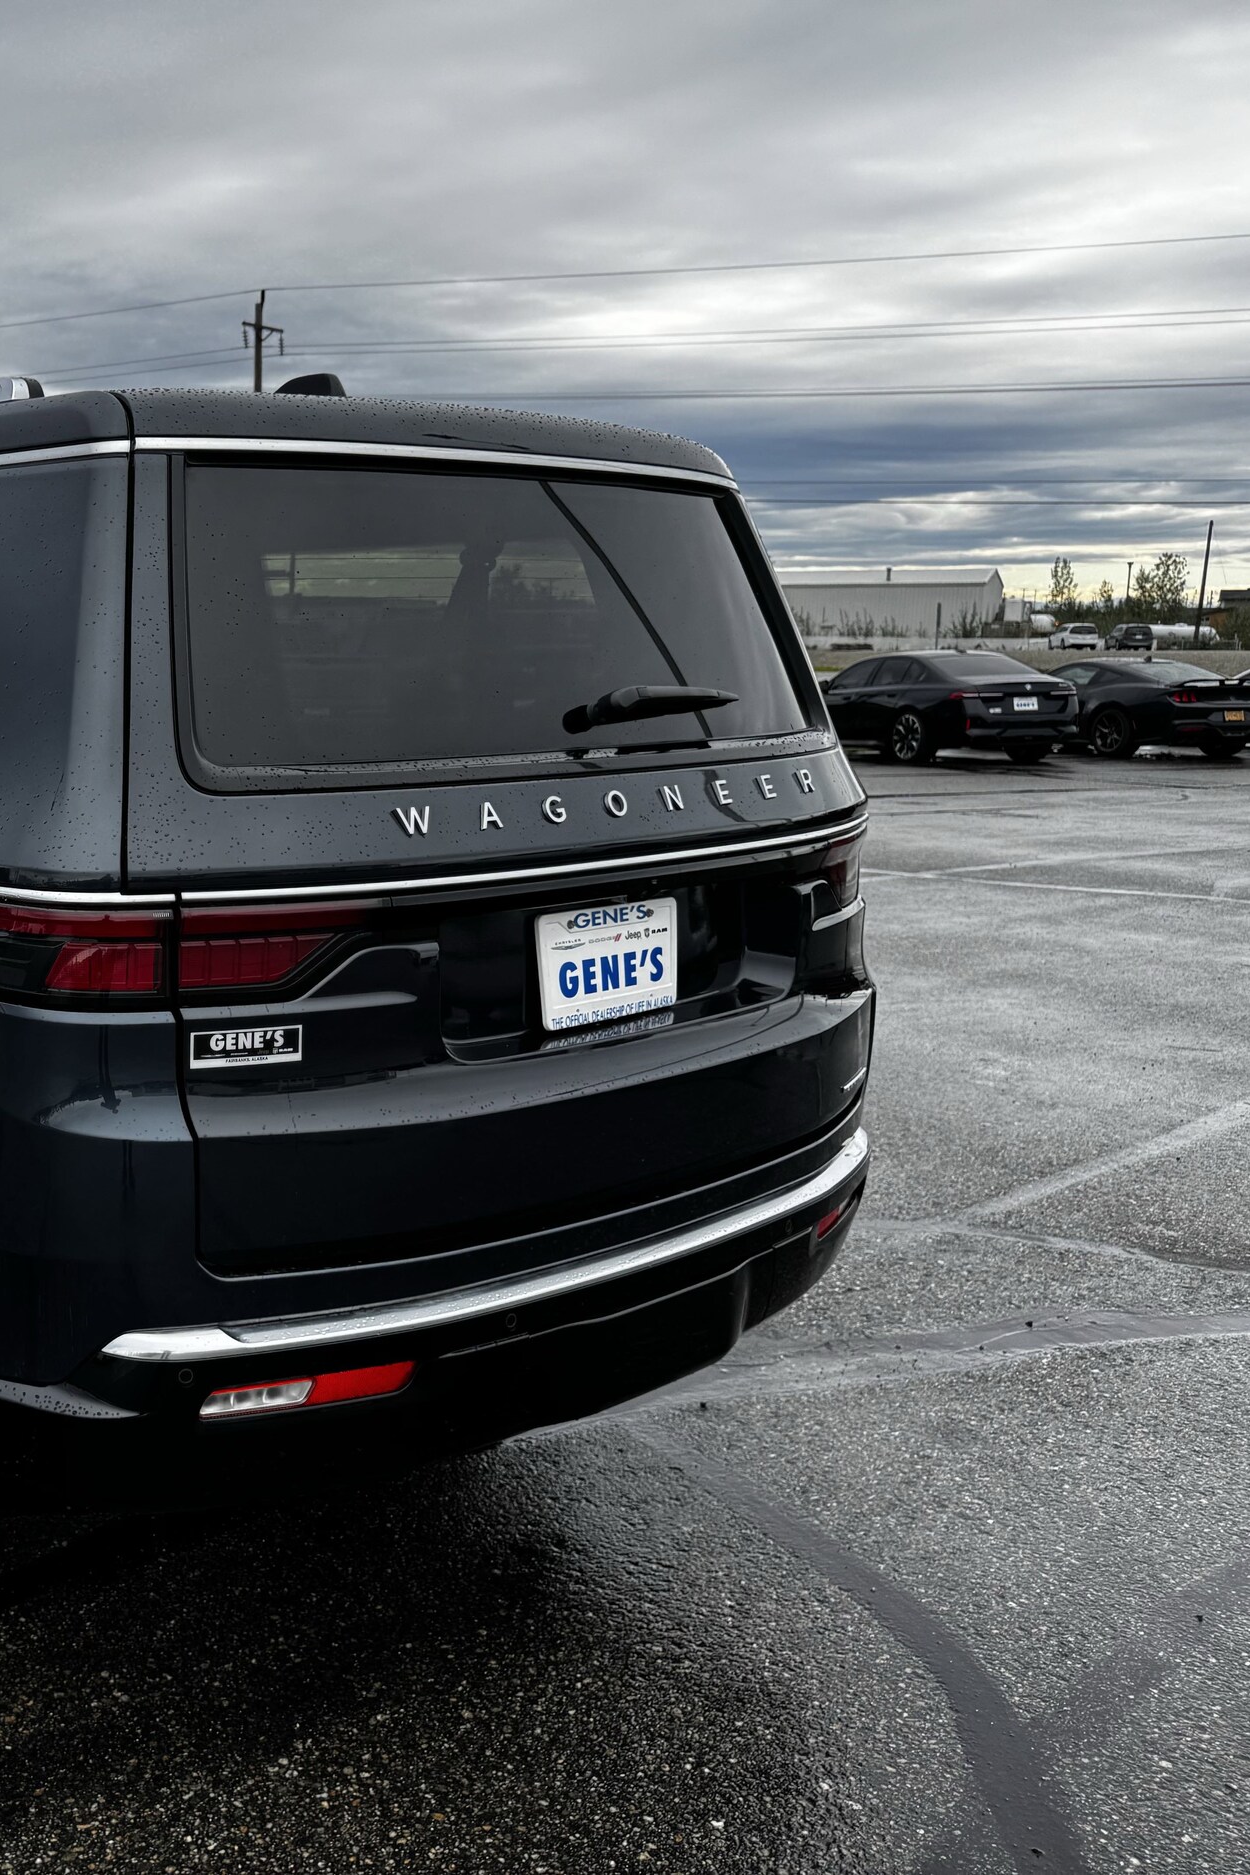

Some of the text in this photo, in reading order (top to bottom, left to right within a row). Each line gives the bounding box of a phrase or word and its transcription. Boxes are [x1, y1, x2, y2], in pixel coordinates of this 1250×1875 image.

[394, 768, 816, 836] WAGONEER
[574, 904, 646, 929] GENE'S
[624, 930, 642, 941] Jeep
[559, 947, 664, 998] GENE'S
[551, 1018, 564, 1031] THE
[565, 1012, 591, 1028] OFFICIAL
[591, 1006, 626, 1022] DEALERSHIP
[625, 1003, 635, 1014] OF
[645, 998, 653, 1009] IN
[653, 996, 673, 1008] ALASKA
[210, 1030, 284, 1051] GENE'S
